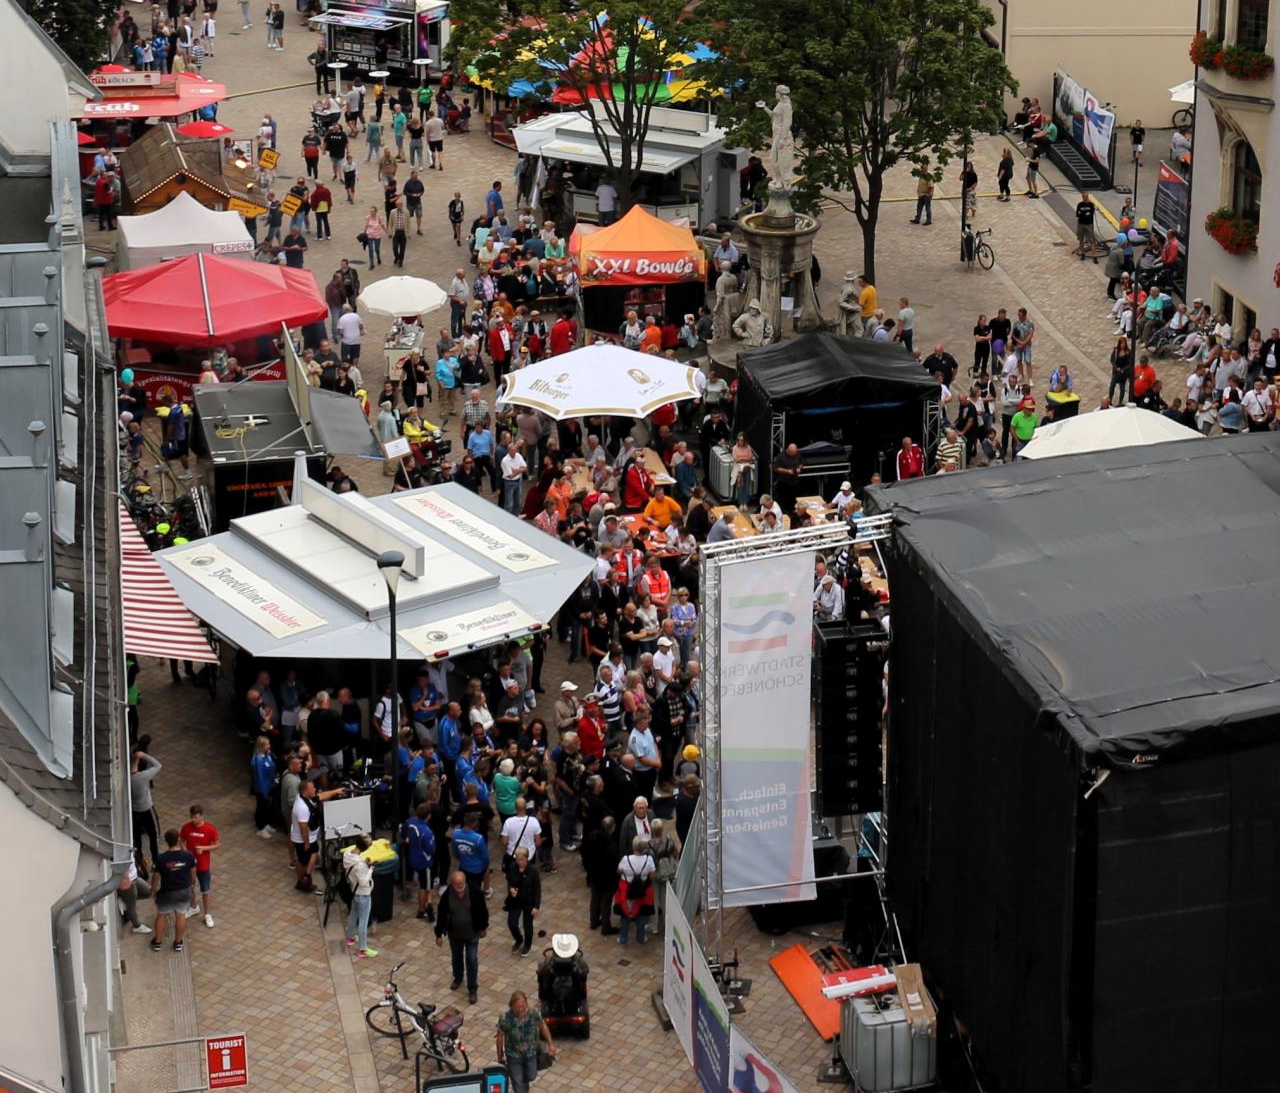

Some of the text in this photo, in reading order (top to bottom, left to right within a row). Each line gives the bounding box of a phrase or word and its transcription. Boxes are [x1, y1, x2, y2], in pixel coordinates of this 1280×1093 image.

[592, 258, 631, 275] XXL
[528, 378, 570, 400] Bitburger
[450, 516, 510, 551] Benediktiner
[208, 566, 302, 629] Benediktiner Weissbier
[456, 610, 518, 632] Benediktiner
[208, 1038, 244, 1050] TOURIST
[210, 1069, 246, 1079] INFORMATION
